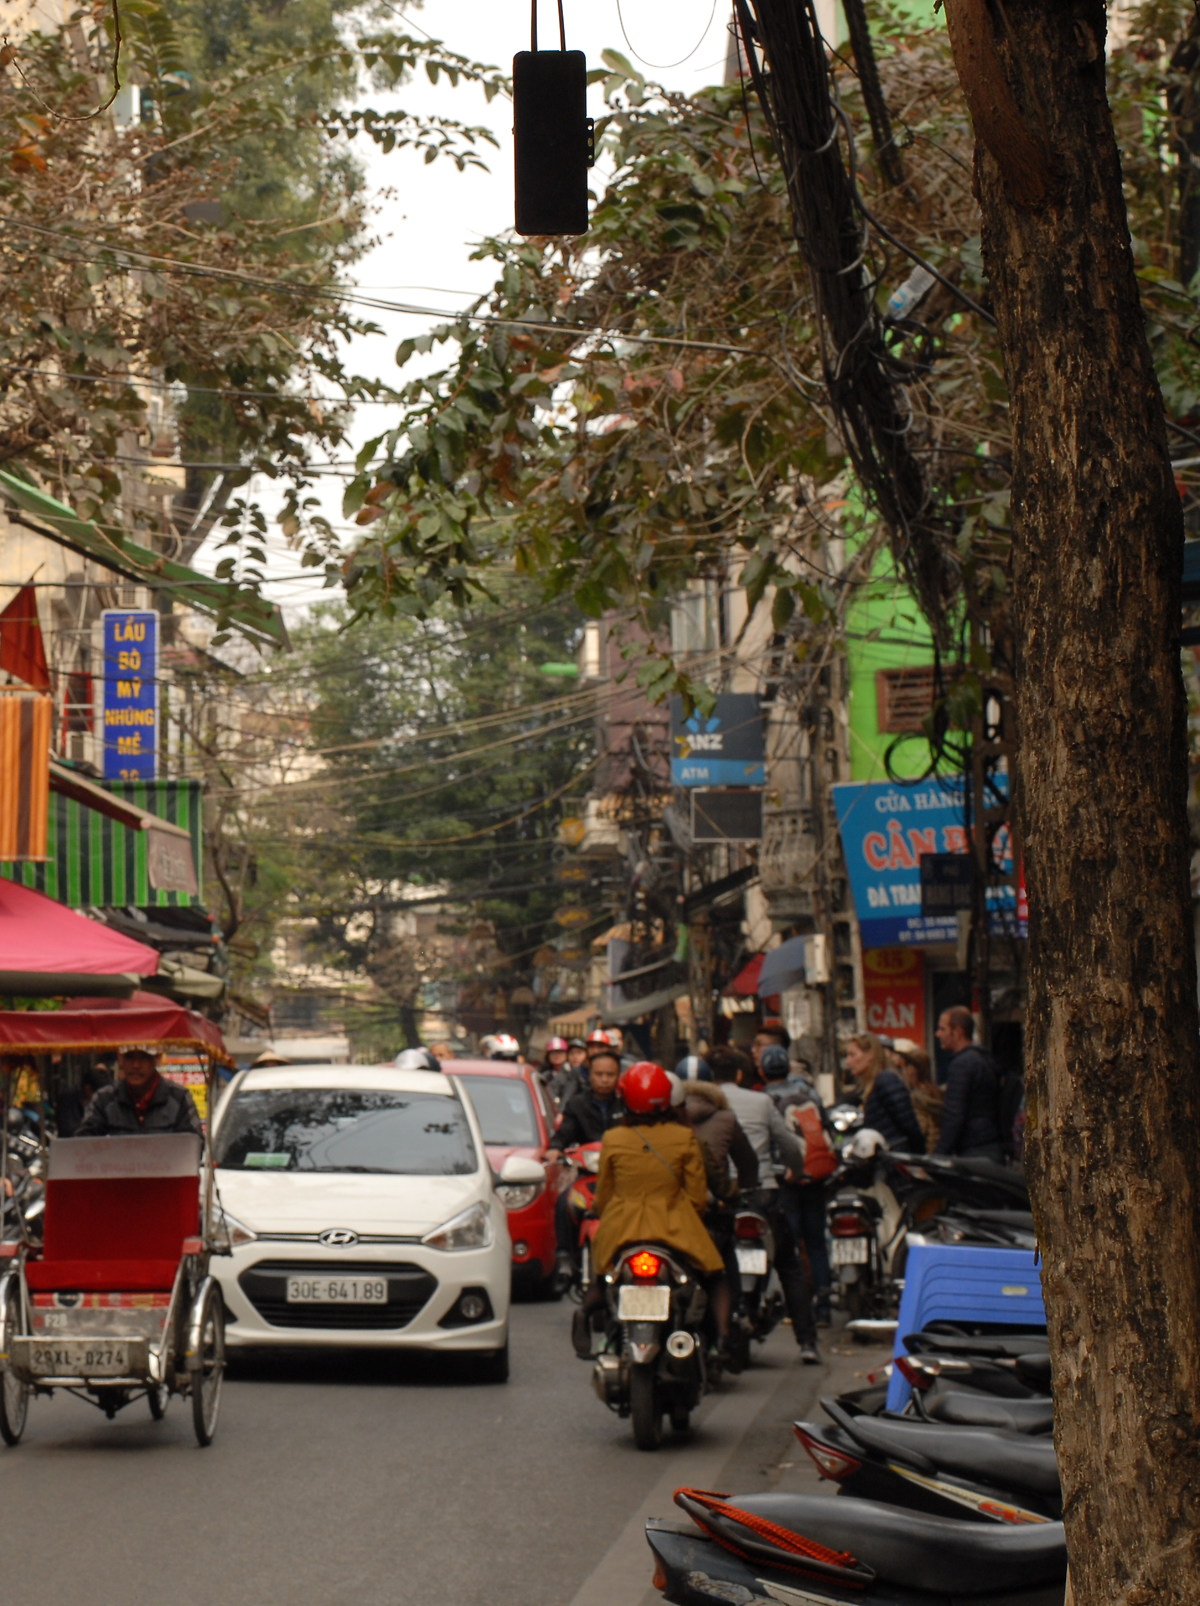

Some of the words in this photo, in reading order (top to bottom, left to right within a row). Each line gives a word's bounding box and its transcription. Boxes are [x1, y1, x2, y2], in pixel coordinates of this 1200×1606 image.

[680, 767, 709, 780] ATM
[867, 995, 917, 1030] CÂN
[289, 1280, 385, 1301] 30E-641.89
